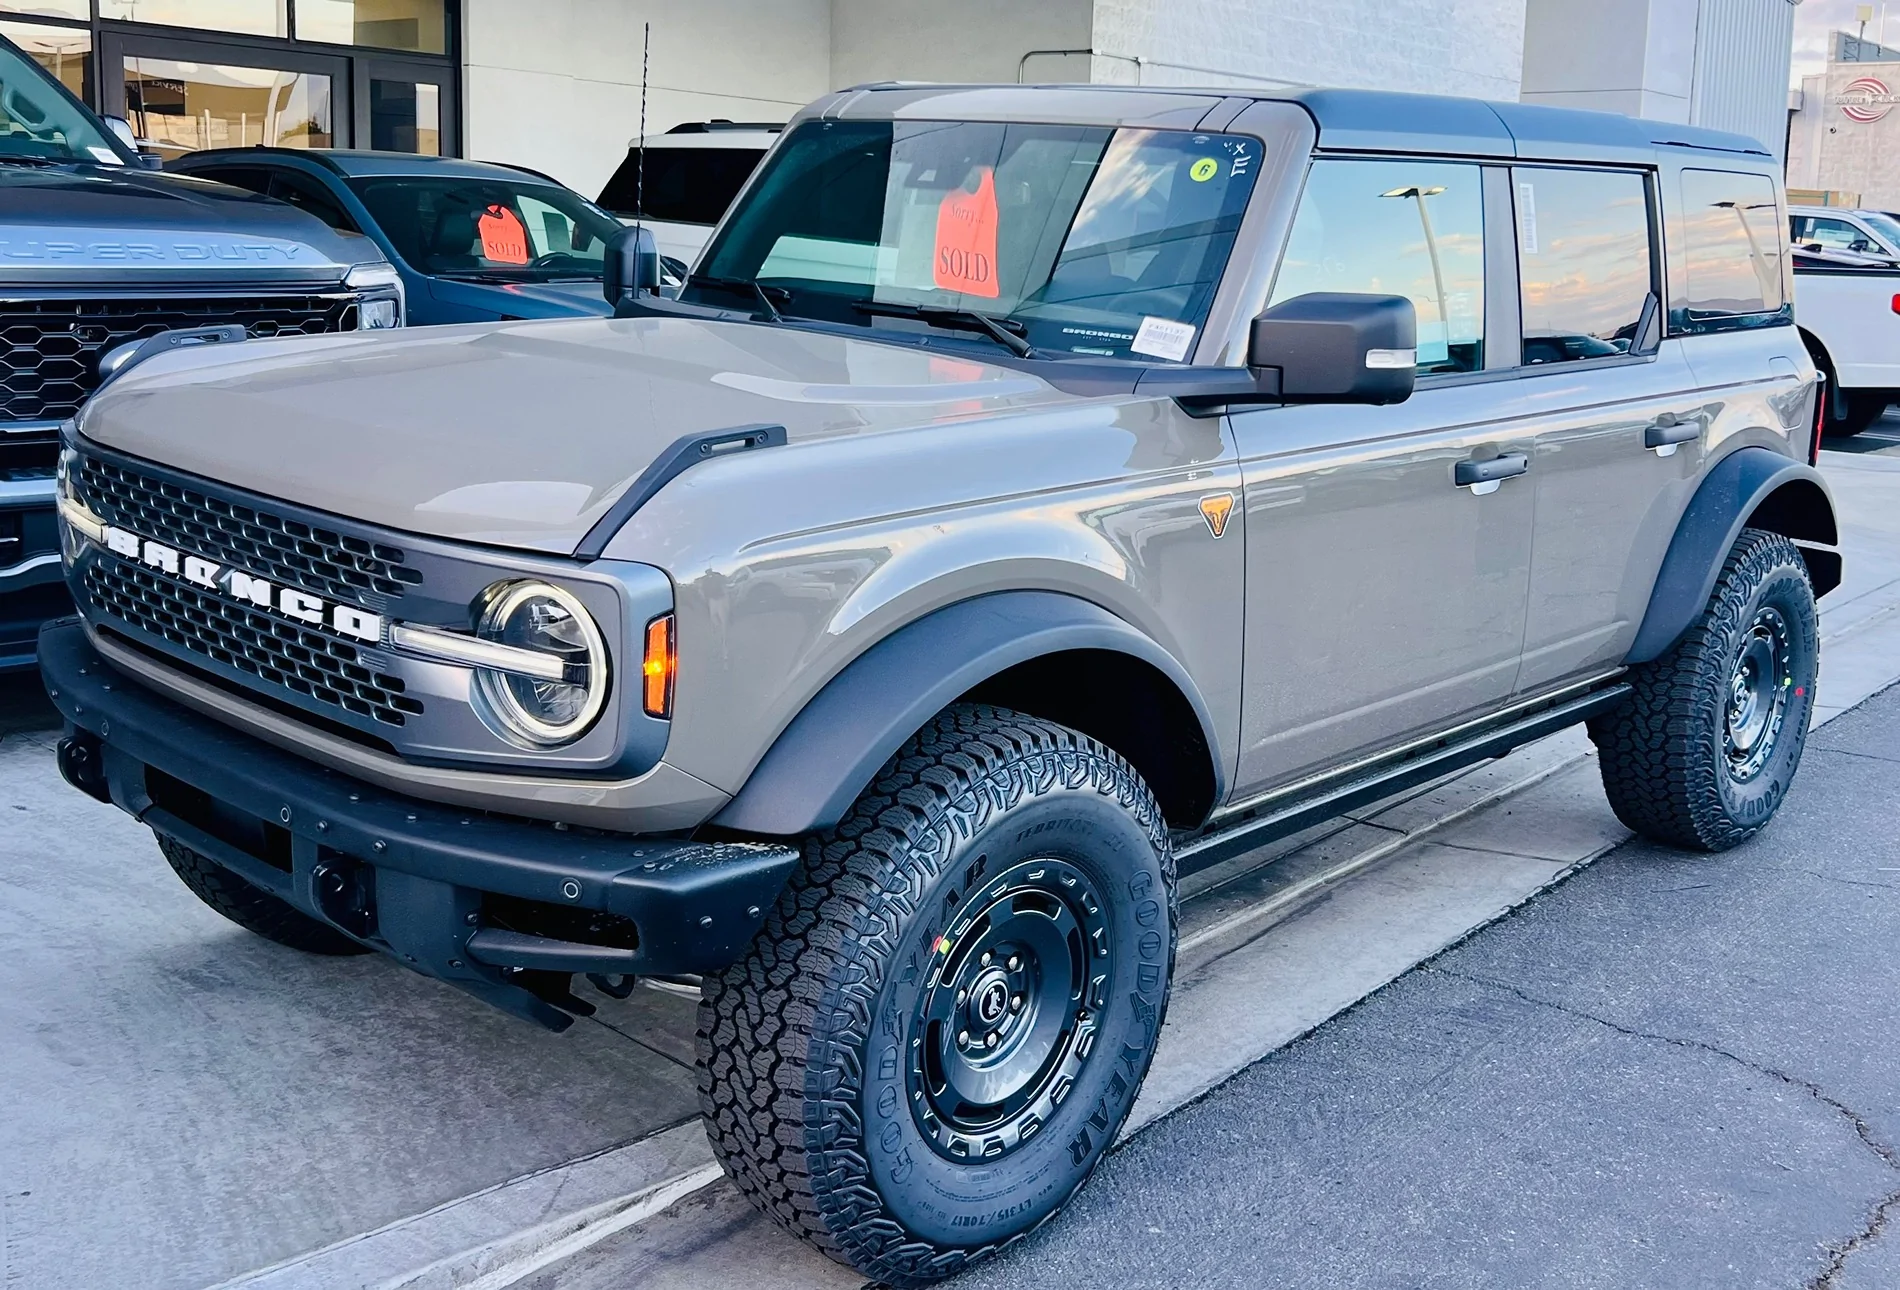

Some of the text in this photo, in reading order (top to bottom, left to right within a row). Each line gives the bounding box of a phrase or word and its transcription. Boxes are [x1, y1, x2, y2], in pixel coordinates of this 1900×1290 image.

[0, 241, 299, 260] UPER DUTY
[486, 241, 521, 257] SOLD
[940, 246, 988, 282] SOLD
[1062, 328, 1133, 340] BRONCO
[108, 526, 381, 642] BRONCO
[878, 854, 986, 1184] GOODYEAR
[1066, 870, 1161, 1167] GOODYEAR
